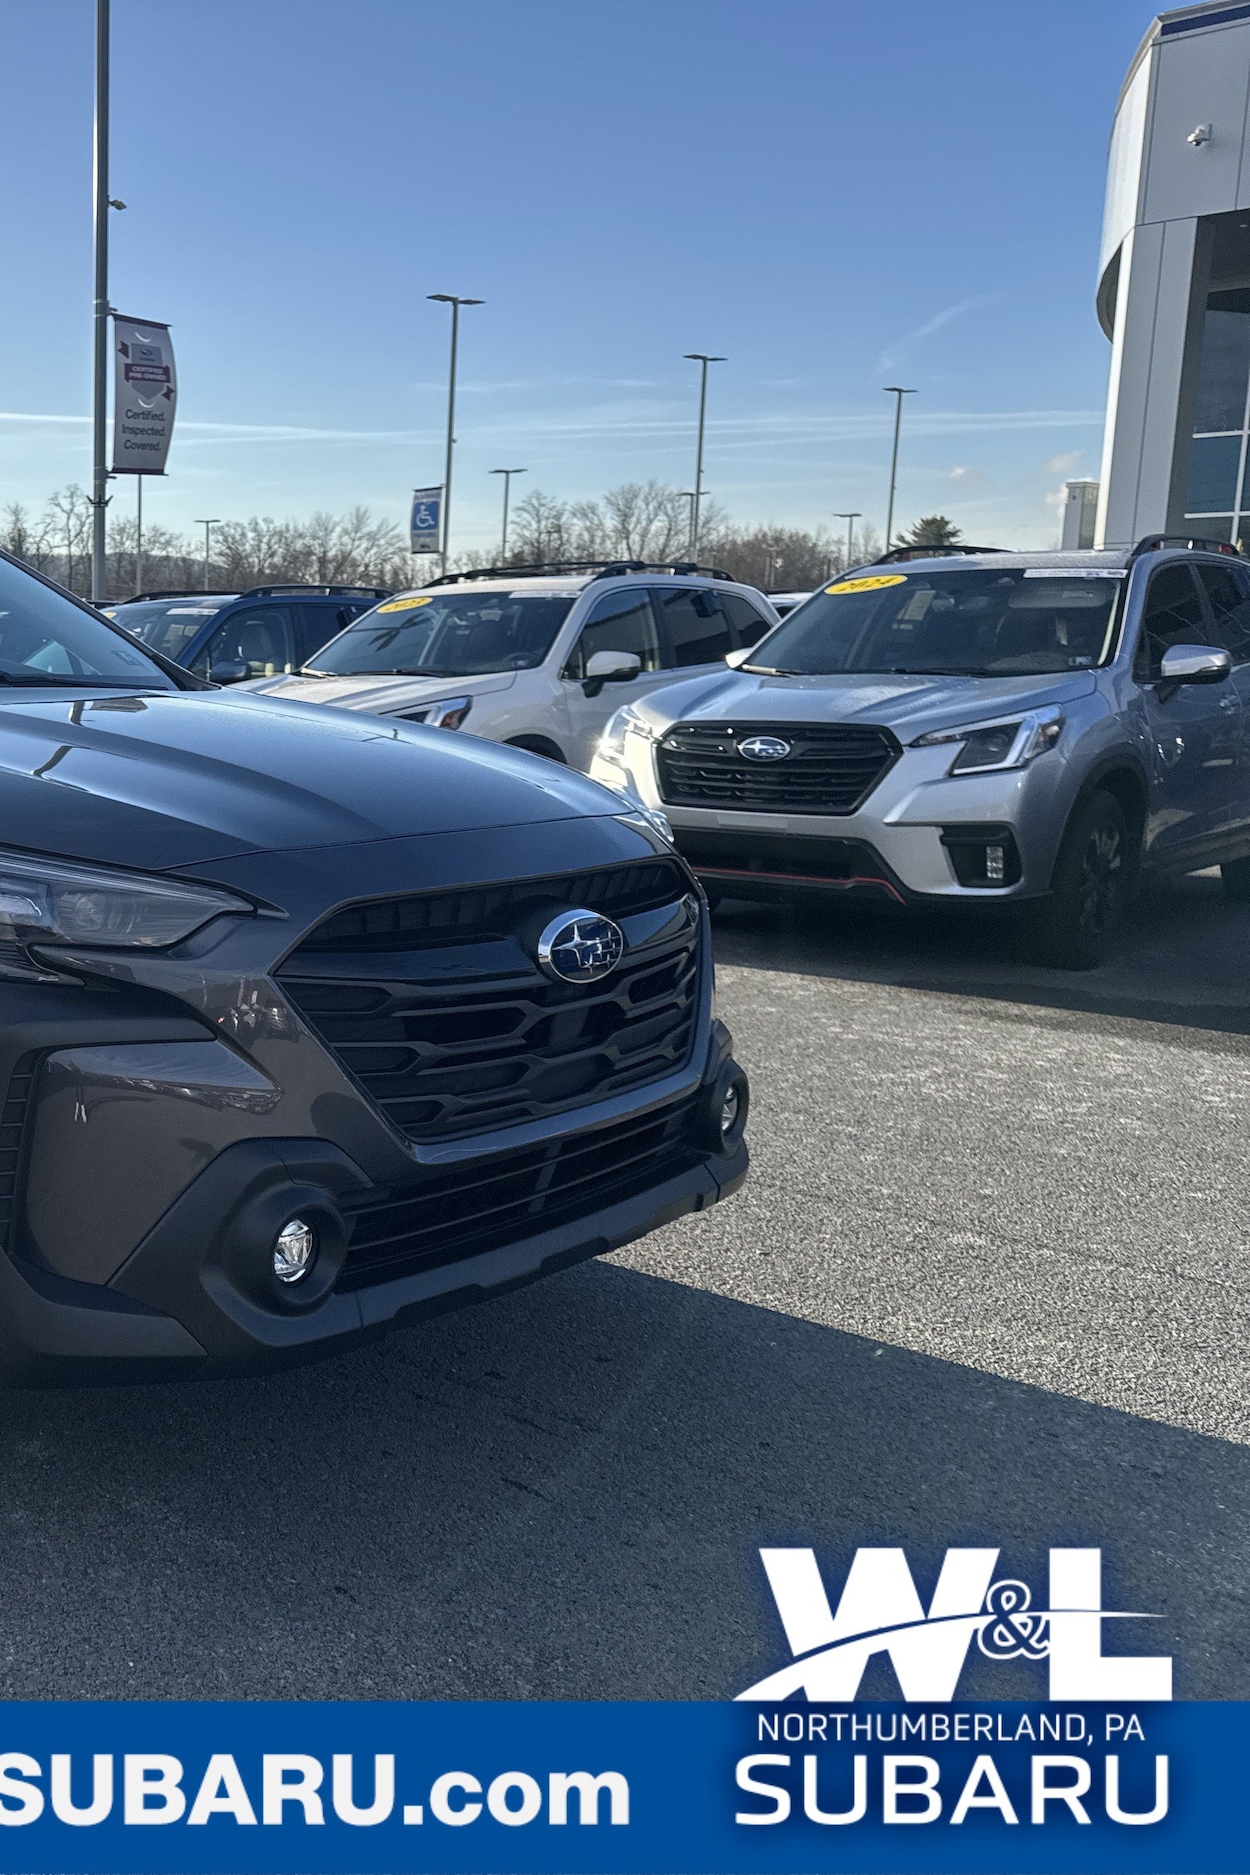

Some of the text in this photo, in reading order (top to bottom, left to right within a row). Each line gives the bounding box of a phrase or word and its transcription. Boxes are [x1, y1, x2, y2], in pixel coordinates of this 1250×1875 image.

[129, 371, 167, 380] PRE-OWNED
[131, 366, 164, 374] CERTIFIED
[125, 408, 166, 421] Certified.
[121, 424, 166, 437] Inspected.
[123, 439, 161, 452] Covered.
